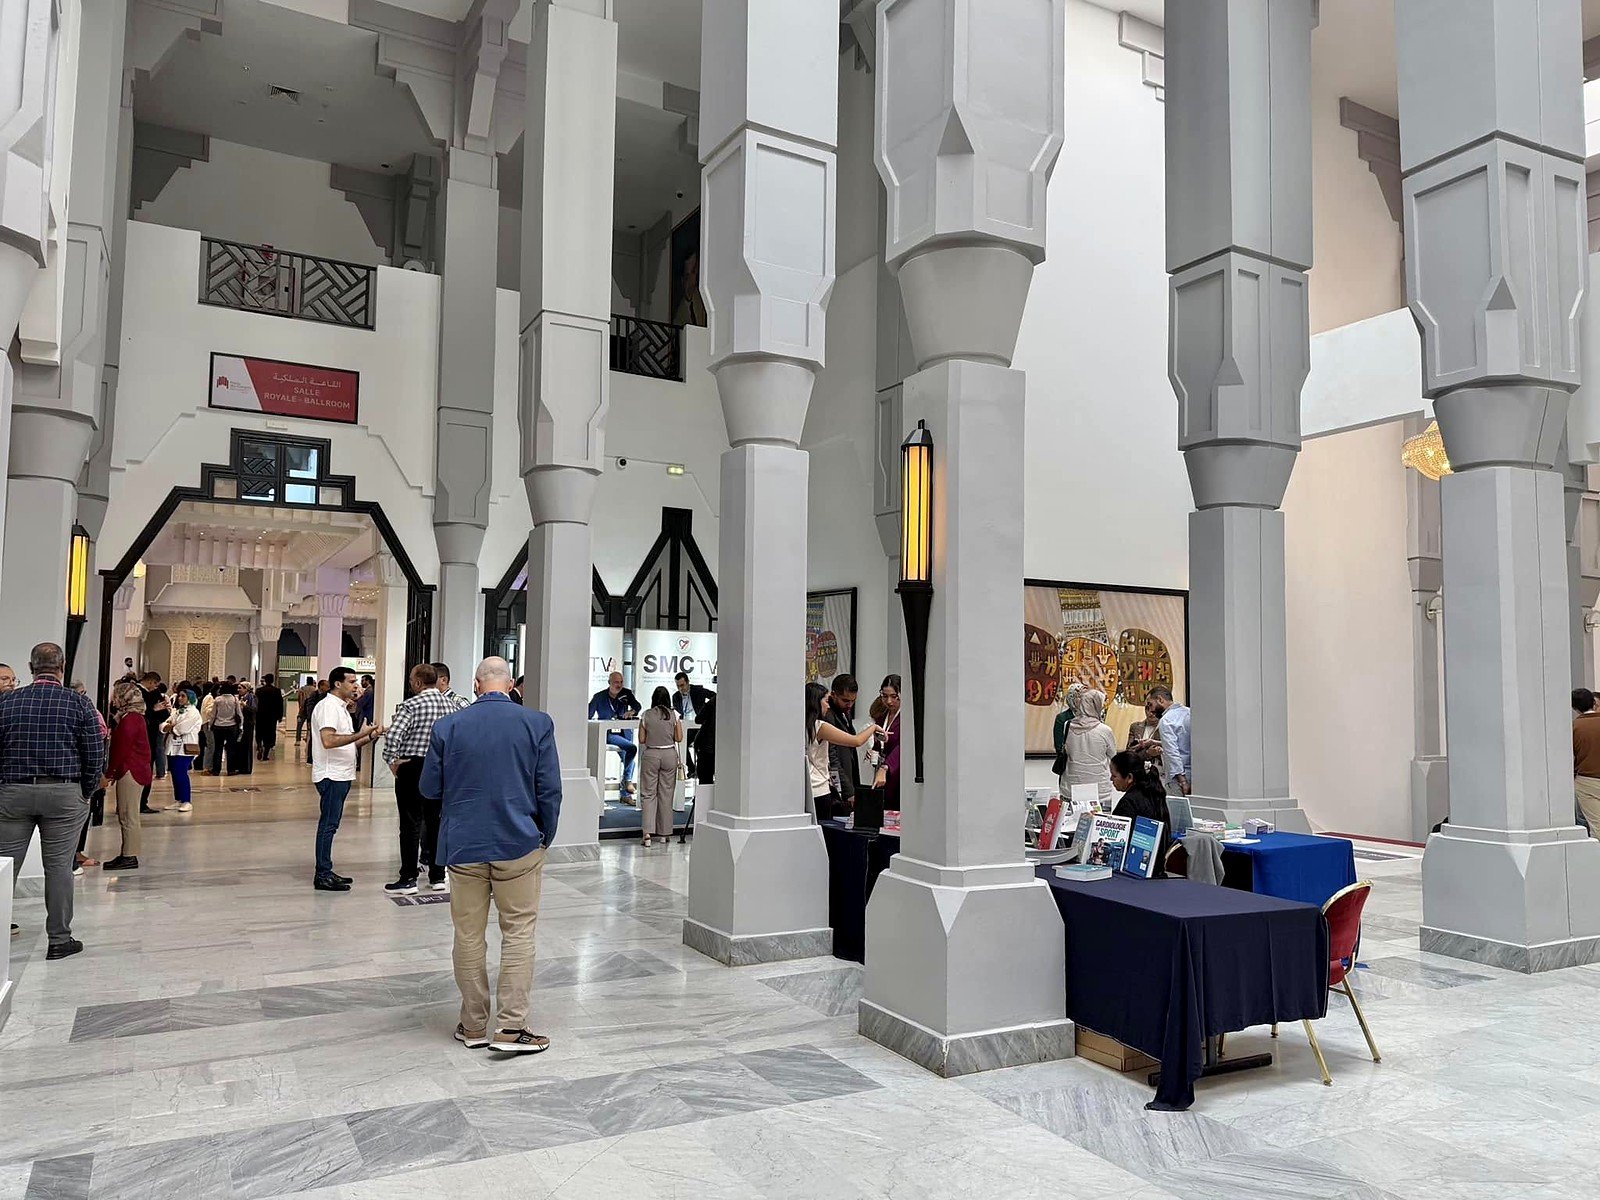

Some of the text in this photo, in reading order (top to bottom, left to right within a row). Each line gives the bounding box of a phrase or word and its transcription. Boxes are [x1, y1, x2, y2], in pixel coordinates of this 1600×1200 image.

[293, 387, 320, 396] SALLE
[264, 392, 297, 403] ROYALE
[304, 397, 350, 409] BALLROOM
[643, 654, 695, 674] SMC
[1099, 828, 1120, 838] SPORT
